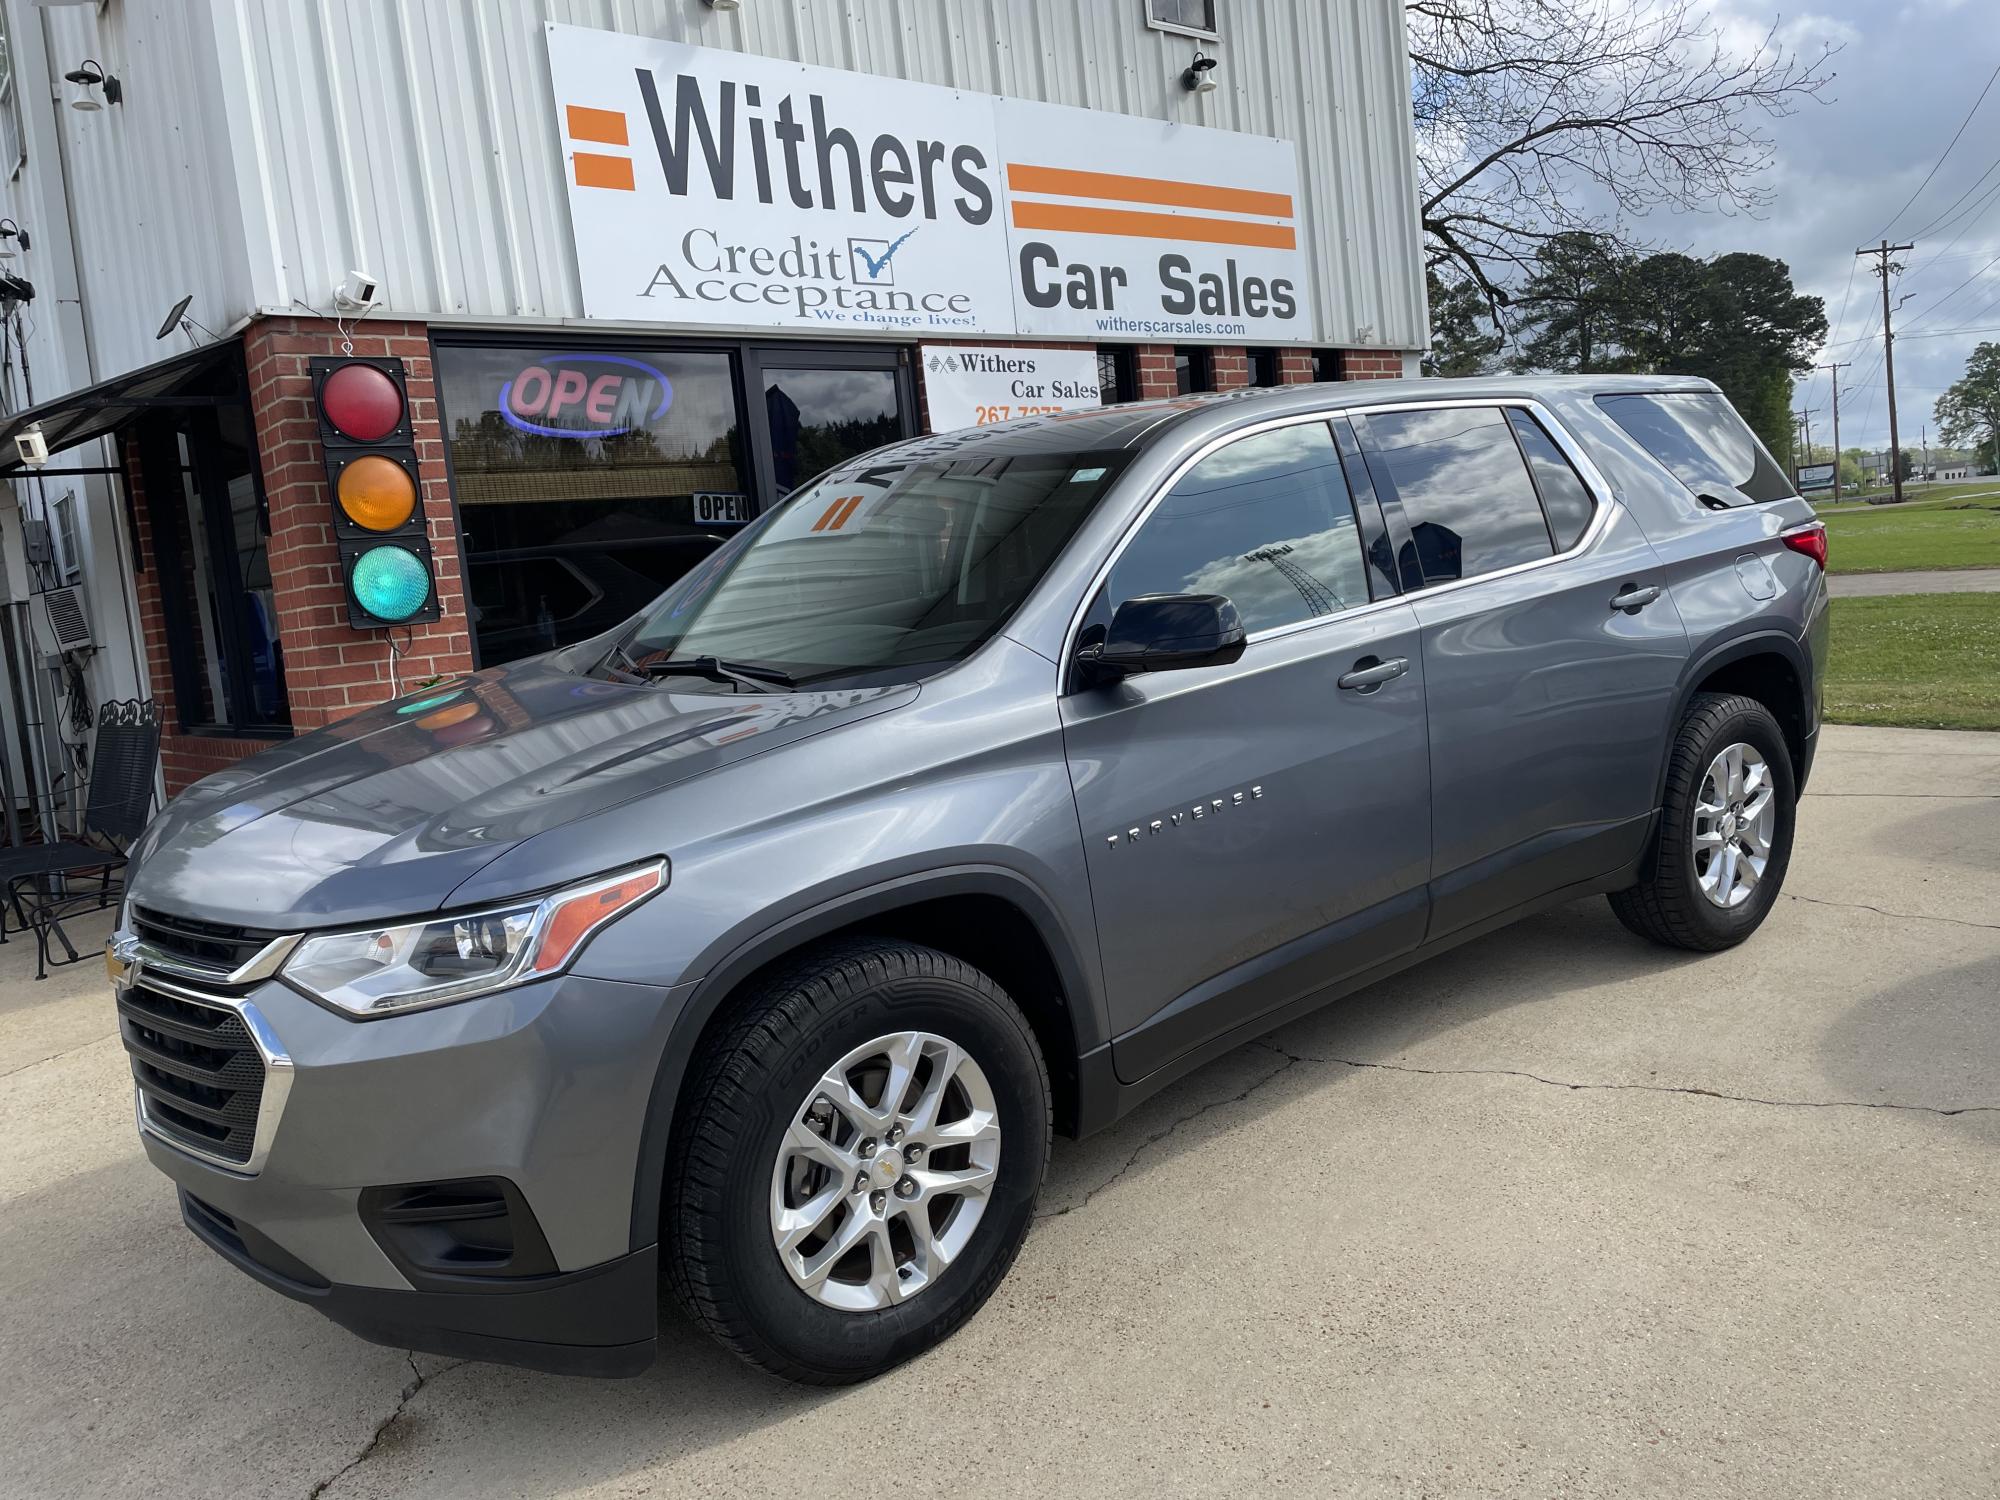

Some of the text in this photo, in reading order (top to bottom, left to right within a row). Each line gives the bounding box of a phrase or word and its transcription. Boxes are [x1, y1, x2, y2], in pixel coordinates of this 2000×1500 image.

[634, 67, 993, 226] Withers
[681, 228, 845, 281] Credit
[636, 263, 972, 318] Acceptance
[1019, 241, 1297, 320] Car Sales
[814, 309, 977, 326] We change lives!
[1096, 316, 1246, 336] witherscarsales.com
[959, 353, 1036, 373] Withers
[511, 366, 655, 426] OPEN
[1011, 380, 1099, 399] Car Sales
[975, 405, 1010, 427] 267
[699, 495, 749, 521] OPEN
[1107, 785, 1263, 849] TRAVERSE
